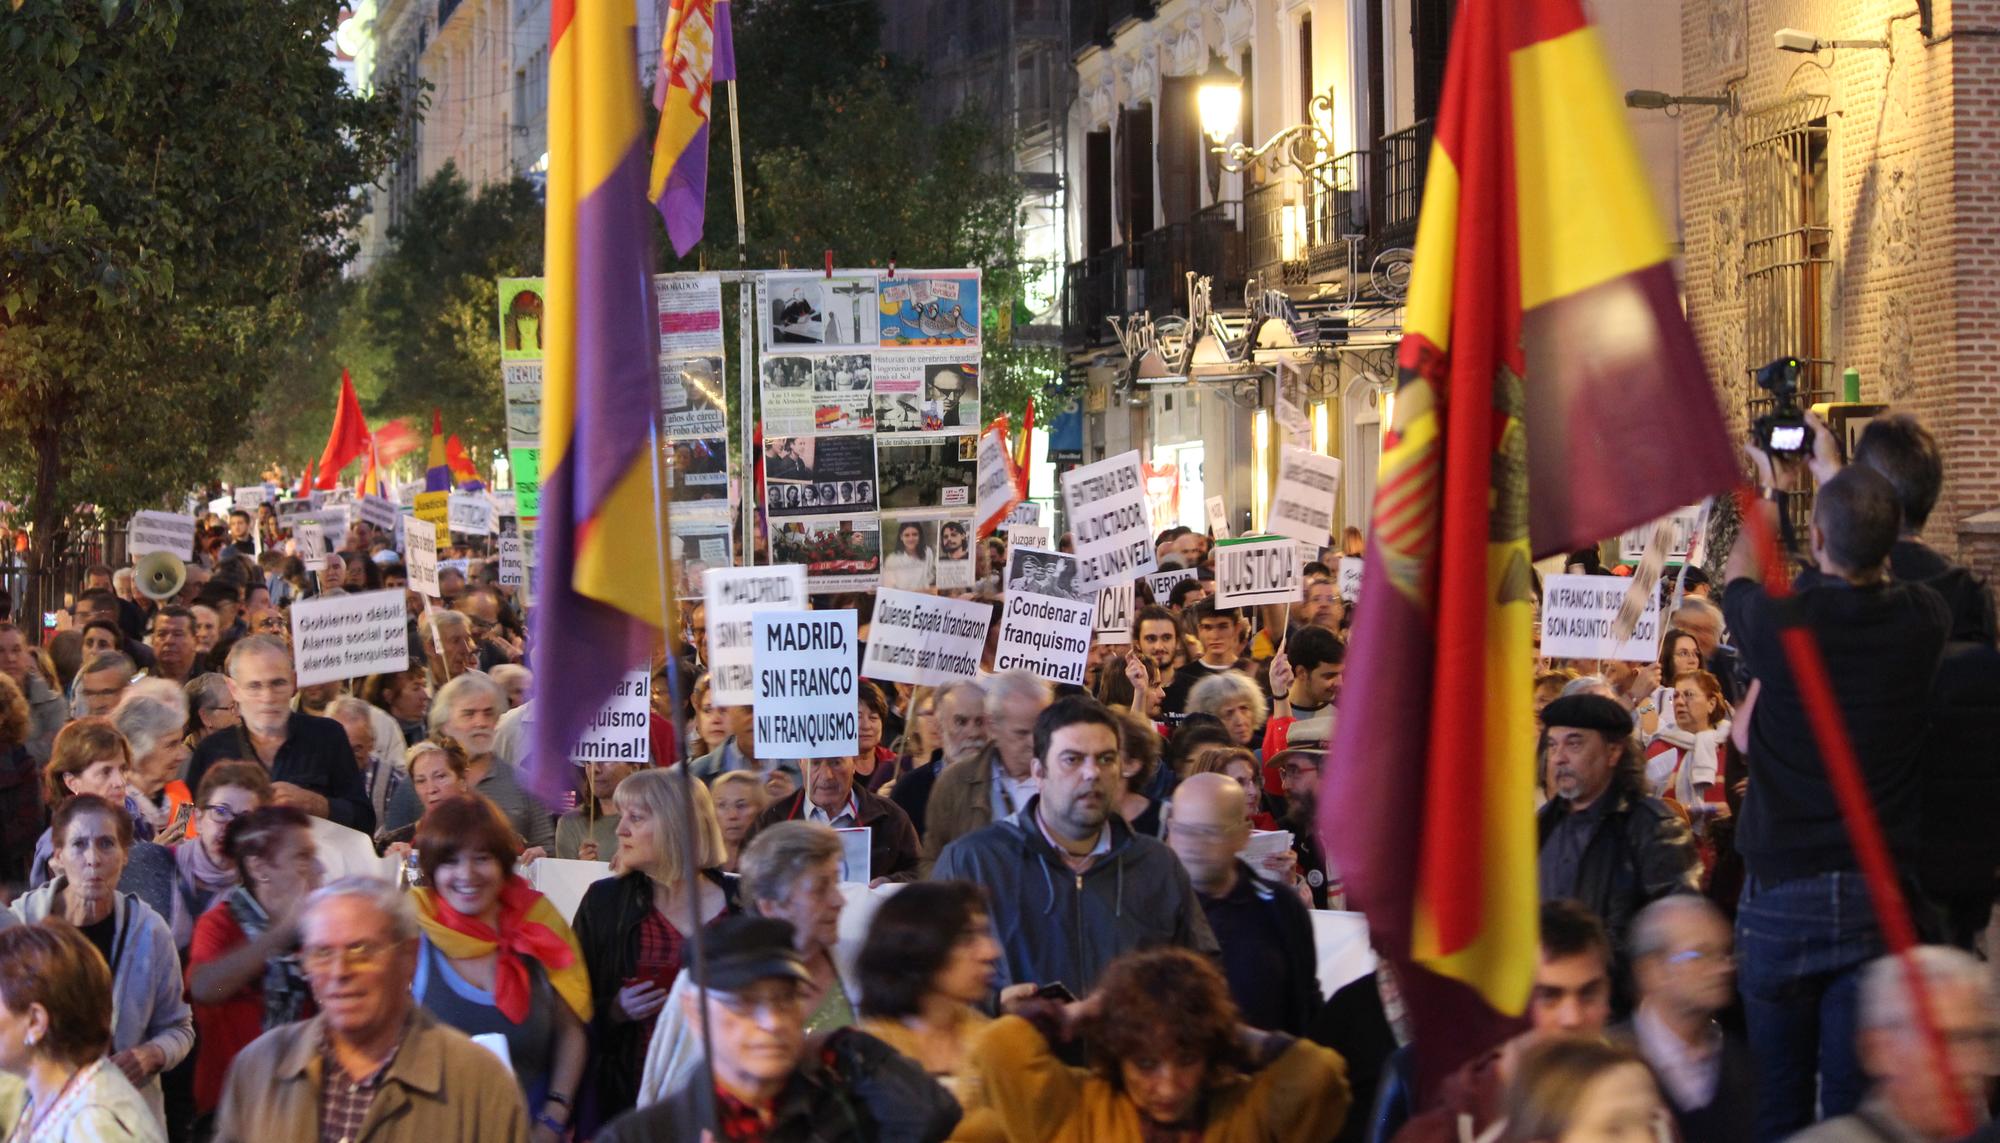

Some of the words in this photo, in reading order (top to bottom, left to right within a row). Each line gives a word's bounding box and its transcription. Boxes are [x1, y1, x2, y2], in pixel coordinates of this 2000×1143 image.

[687, 411, 696, 421] de
[691, 422, 701, 434] de
[1117, 464, 1139, 493] BIEN
[1037, 536, 1047, 548] ya
[1081, 557, 1099, 582] DE
[1100, 549, 1128, 578] UNA
[1007, 596, 1079, 624] ¡Condenar
[1080, 608, 1093, 627] al
[1560, 590, 1594, 611] FRANCO
[300, 610, 363, 633] Gobierno
[911, 604, 943, 637] España
[1547, 618, 1567, 638] SON
[1569, 618, 1608, 639] ASUNTO
[302, 636, 343, 652] Alarma
[346, 626, 381, 645] social
[385, 627, 404, 643] por
[767, 621, 847, 655] MADRID,
[1004, 623, 1087, 655] franquismo
[303, 650, 343, 673] alardes
[916, 648, 936, 669] sean
[999, 653, 1083, 682] criminal!
[635, 676, 648, 697] al
[762, 668, 786, 698] SIN
[791, 666, 852, 697] FRANCO
[758, 715, 771, 744] NI
[775, 712, 857, 748] FRANQUISMO.
